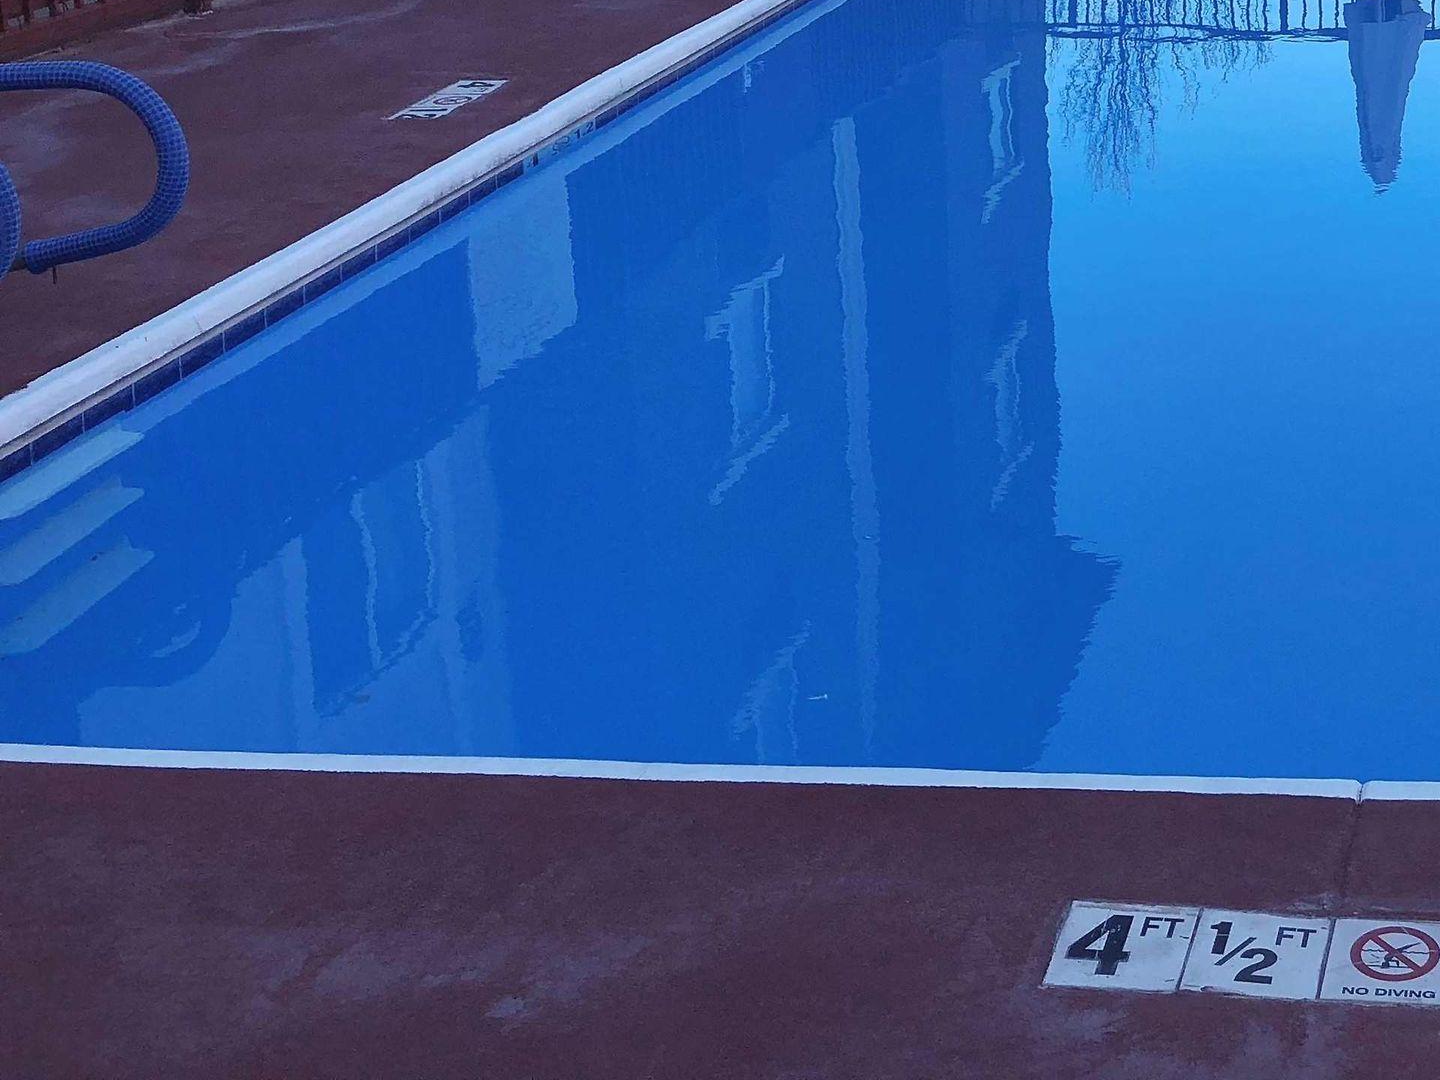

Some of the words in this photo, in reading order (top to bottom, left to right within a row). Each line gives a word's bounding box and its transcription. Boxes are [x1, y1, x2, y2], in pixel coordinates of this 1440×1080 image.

[1065, 913, 1133, 976] 4
[1140, 917, 1184, 939] FT
[1275, 926, 1318, 949] FT
[1341, 986, 1369, 997] NO
[1374, 987, 1437, 999] DIVING
